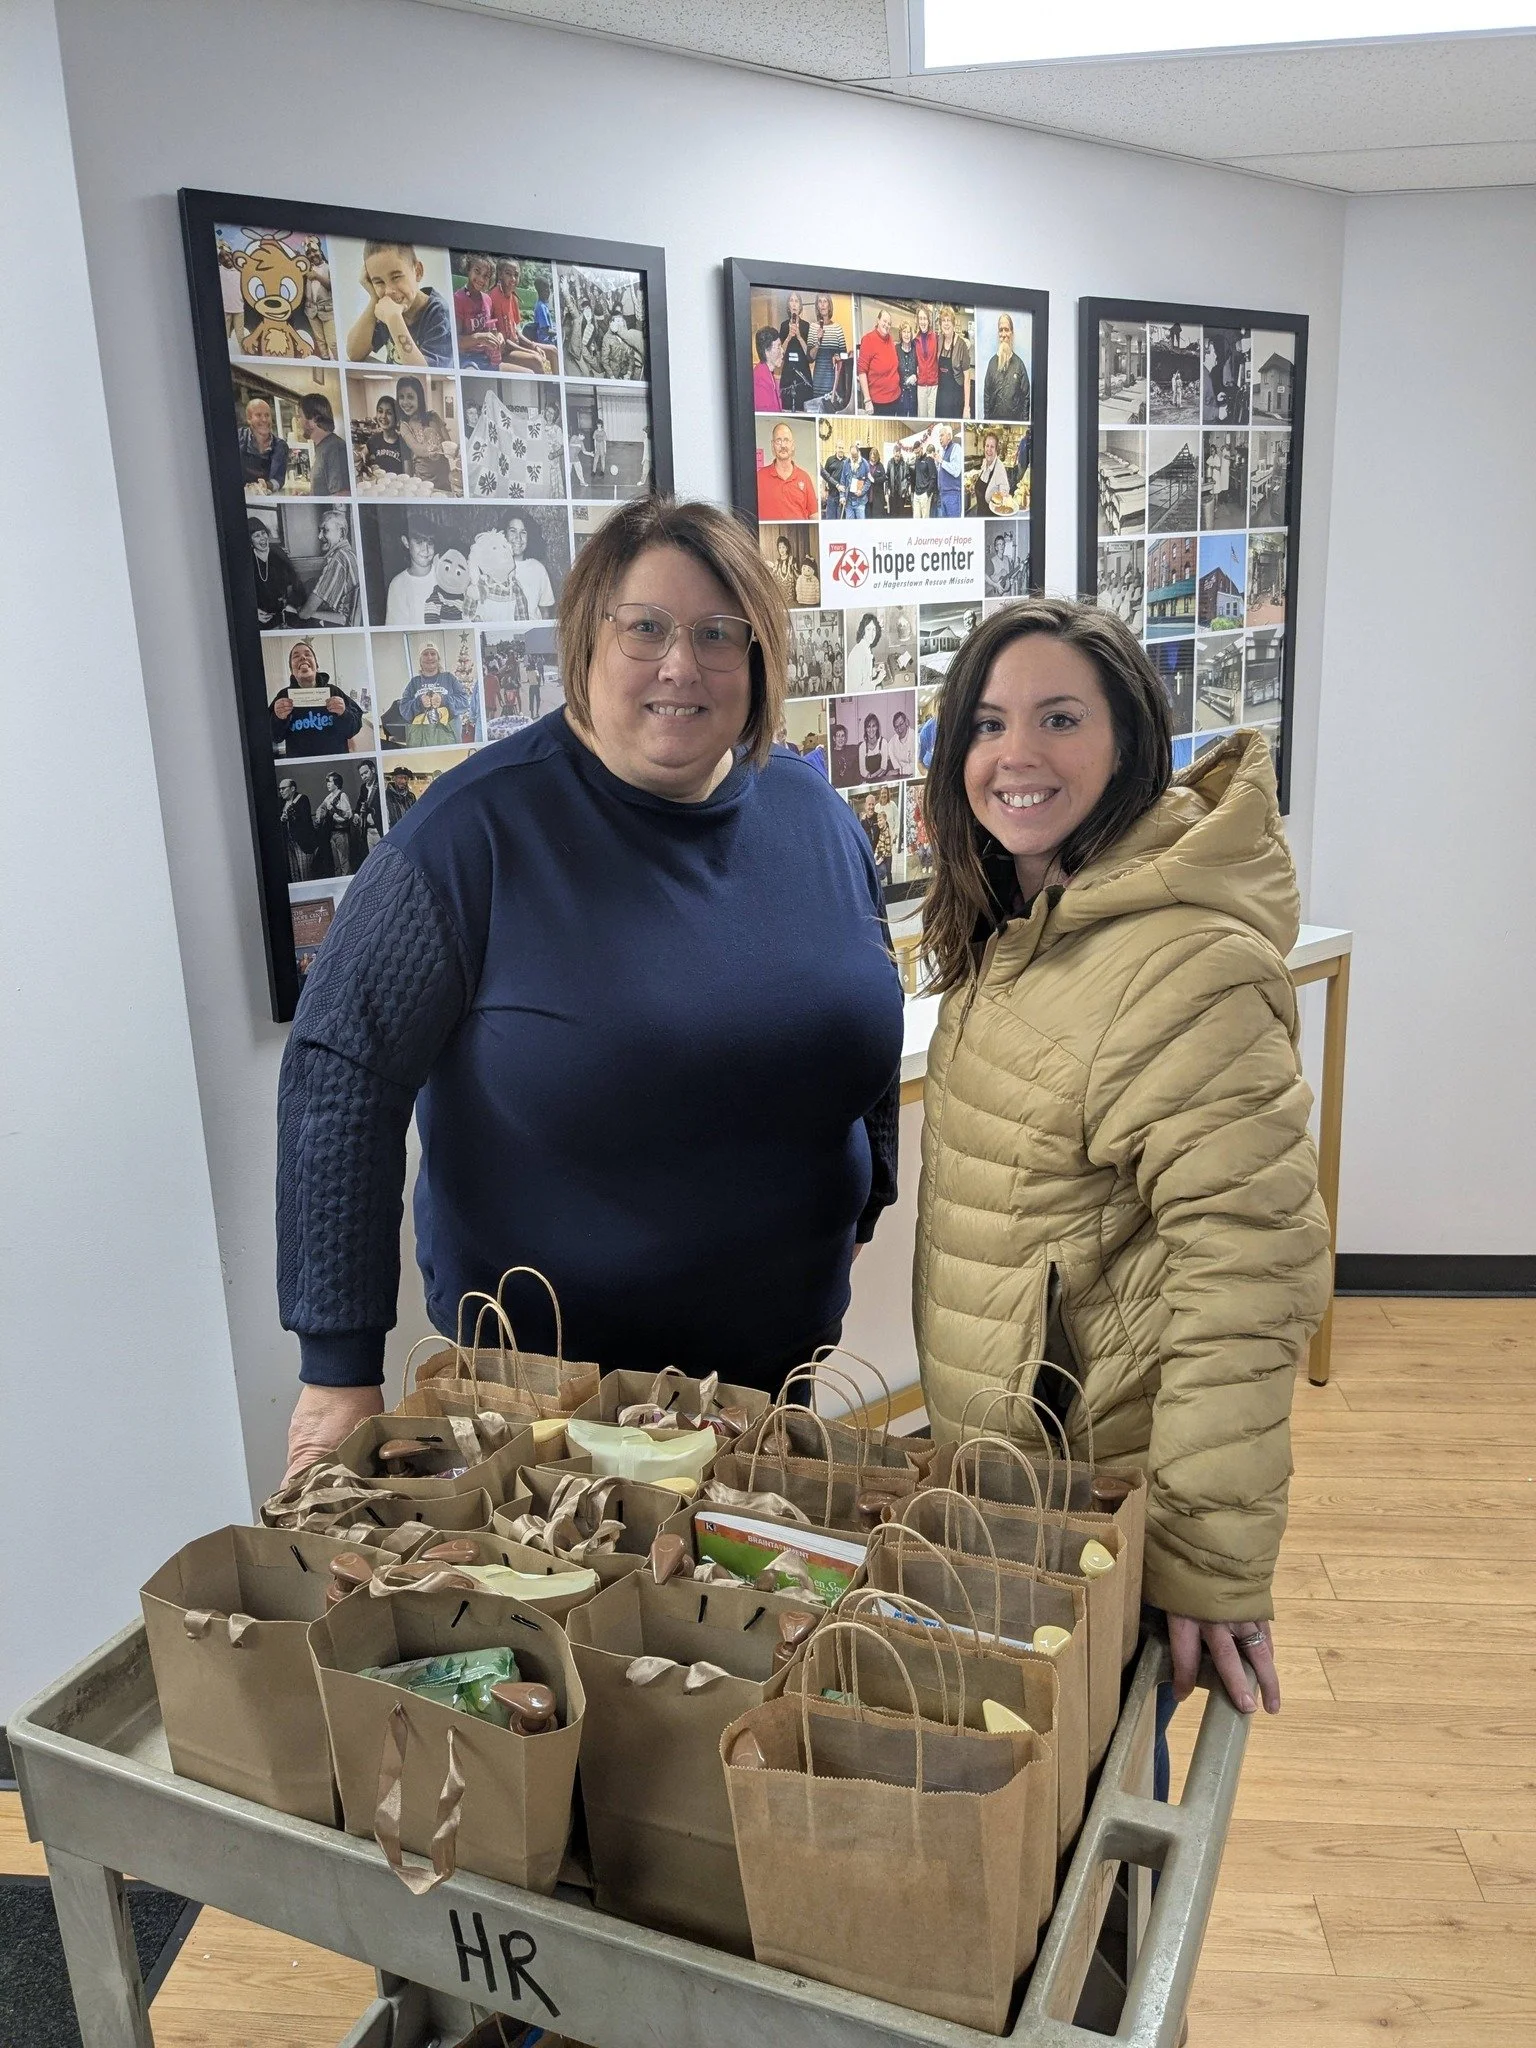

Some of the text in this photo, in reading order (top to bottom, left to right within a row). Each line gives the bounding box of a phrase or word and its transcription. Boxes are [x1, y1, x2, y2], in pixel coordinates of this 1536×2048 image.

[878, 542, 893, 551] THE
[907, 536, 972, 547] A Journey of Hope
[872, 546, 974, 580] hope center
[883, 580, 923, 589] Hagerstown
[949, 577, 974, 585] Mission
[449, 1908, 561, 2018] HR
